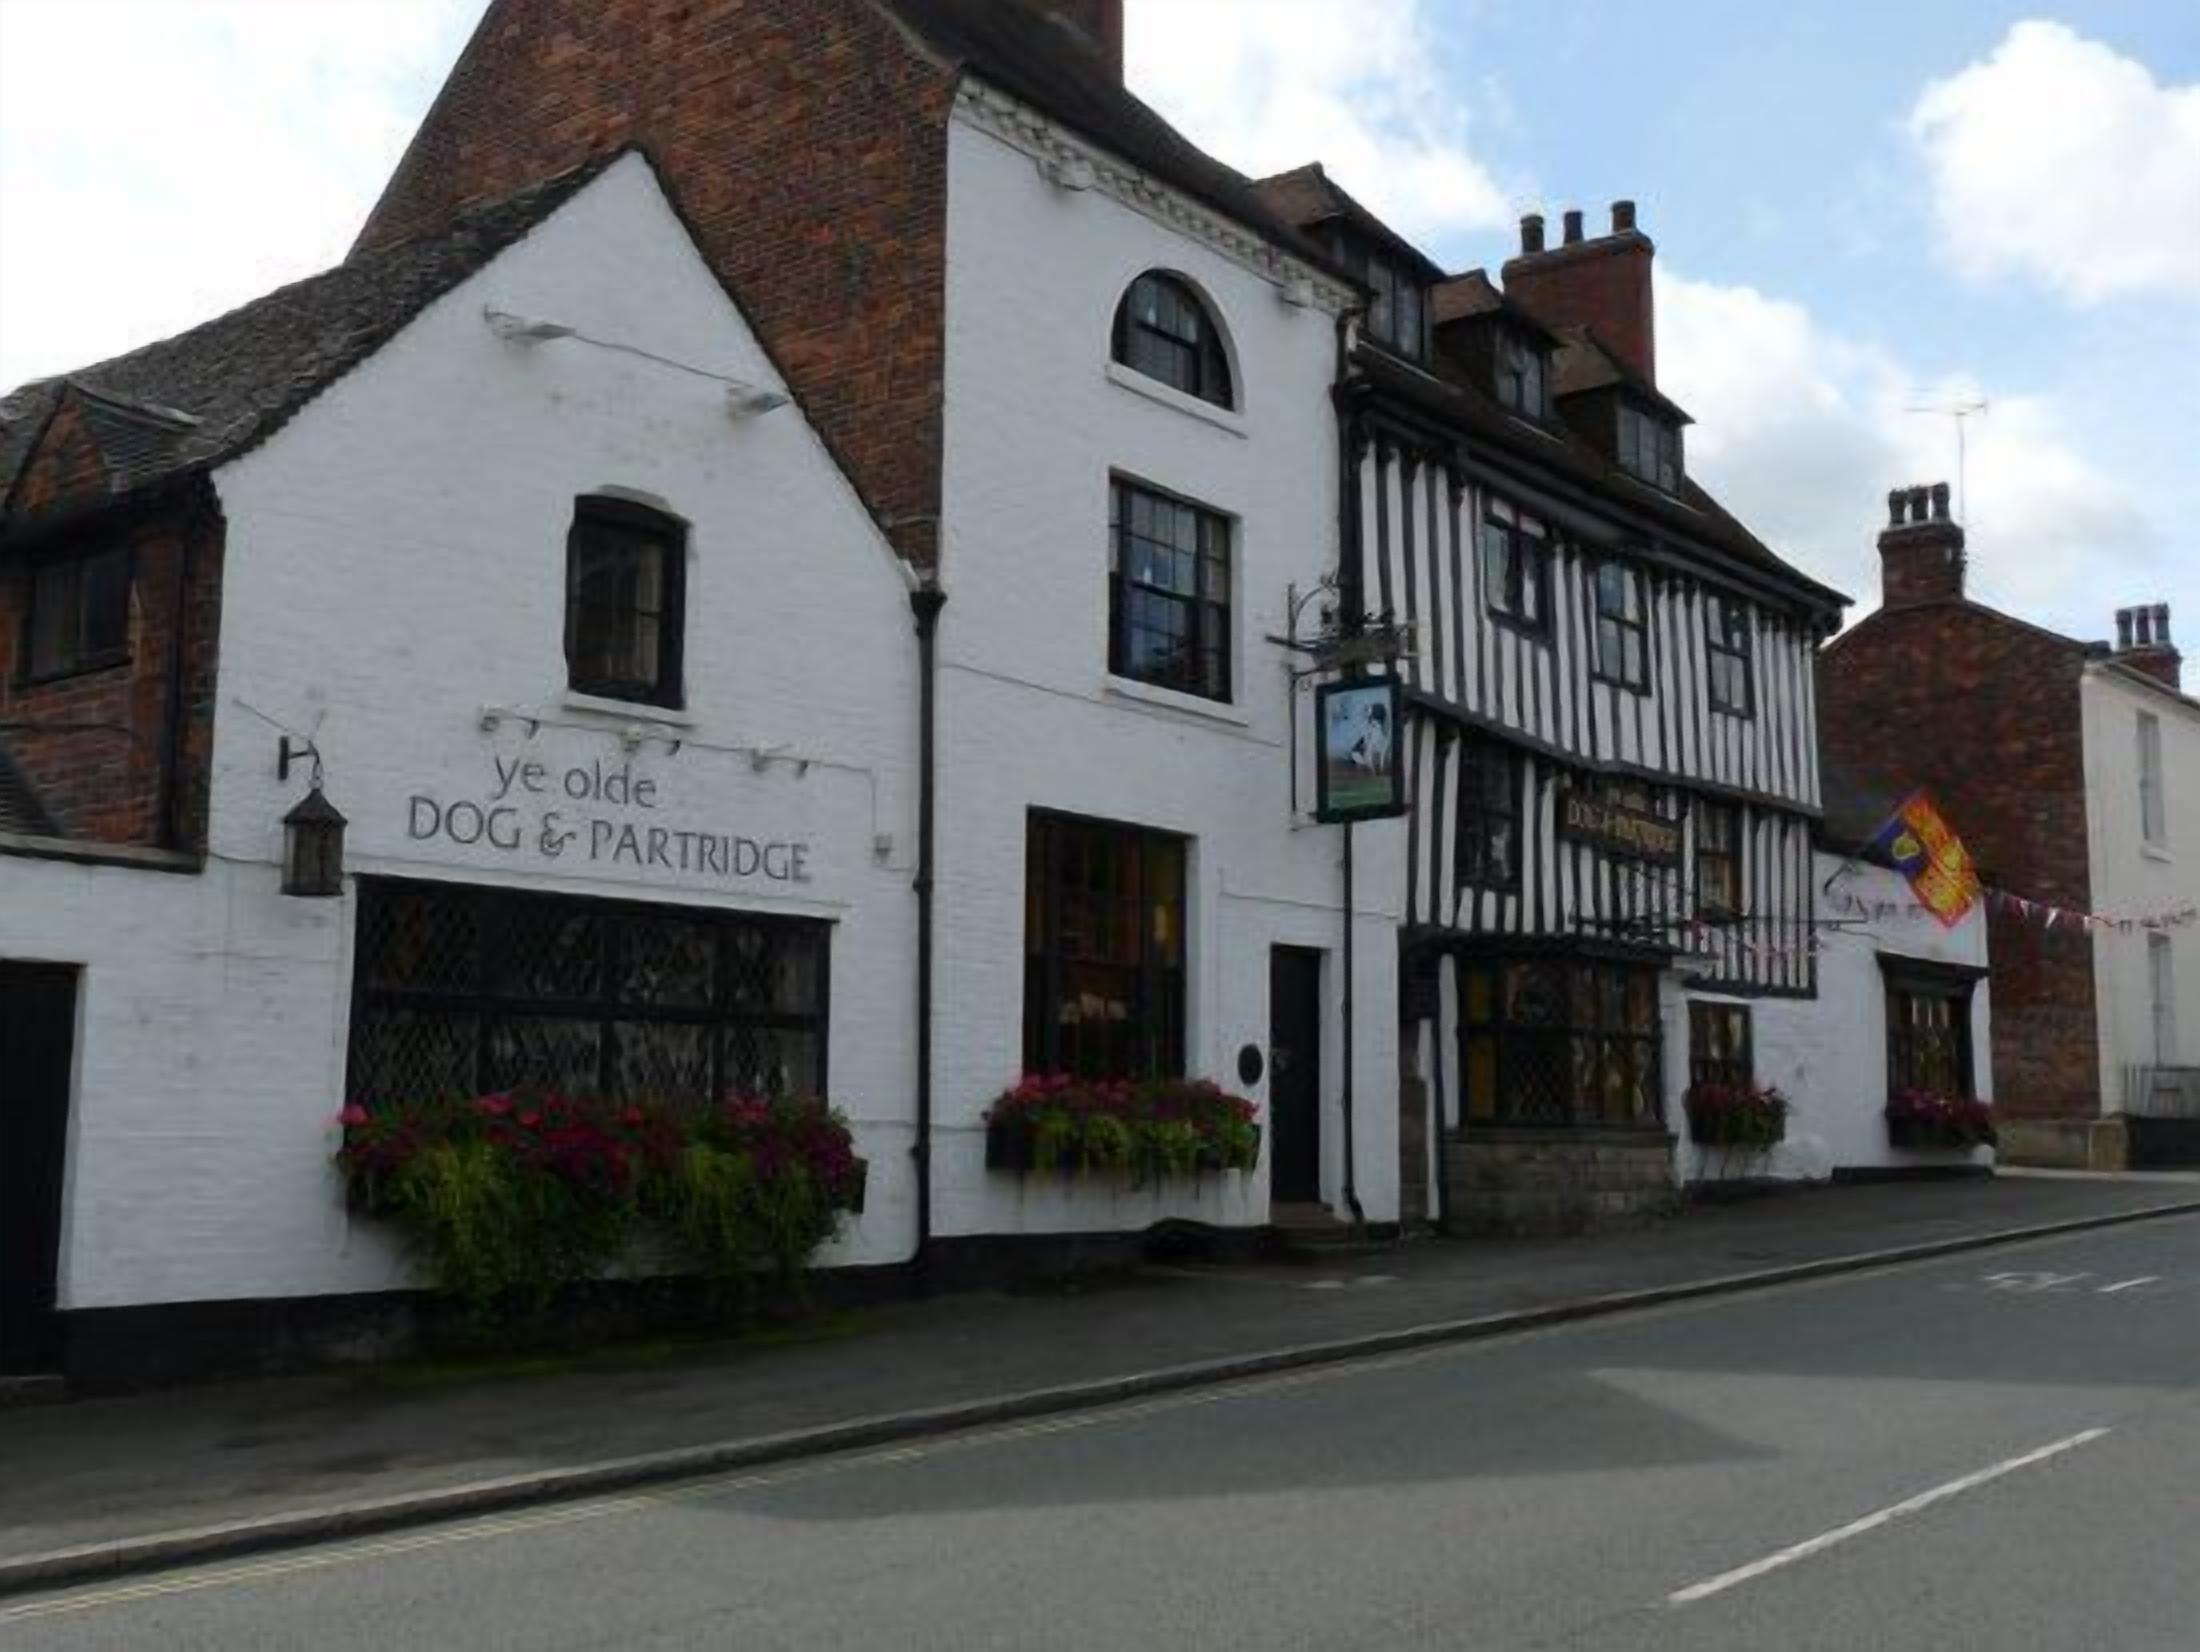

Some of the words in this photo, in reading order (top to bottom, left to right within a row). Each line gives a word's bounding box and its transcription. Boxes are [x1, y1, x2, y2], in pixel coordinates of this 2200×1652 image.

[493, 755, 546, 801] ye
[564, 757, 656, 808] olde
[408, 795, 521, 849] DOG
[540, 811, 577, 857] &
[590, 819, 812, 882] PARTRIDGE
